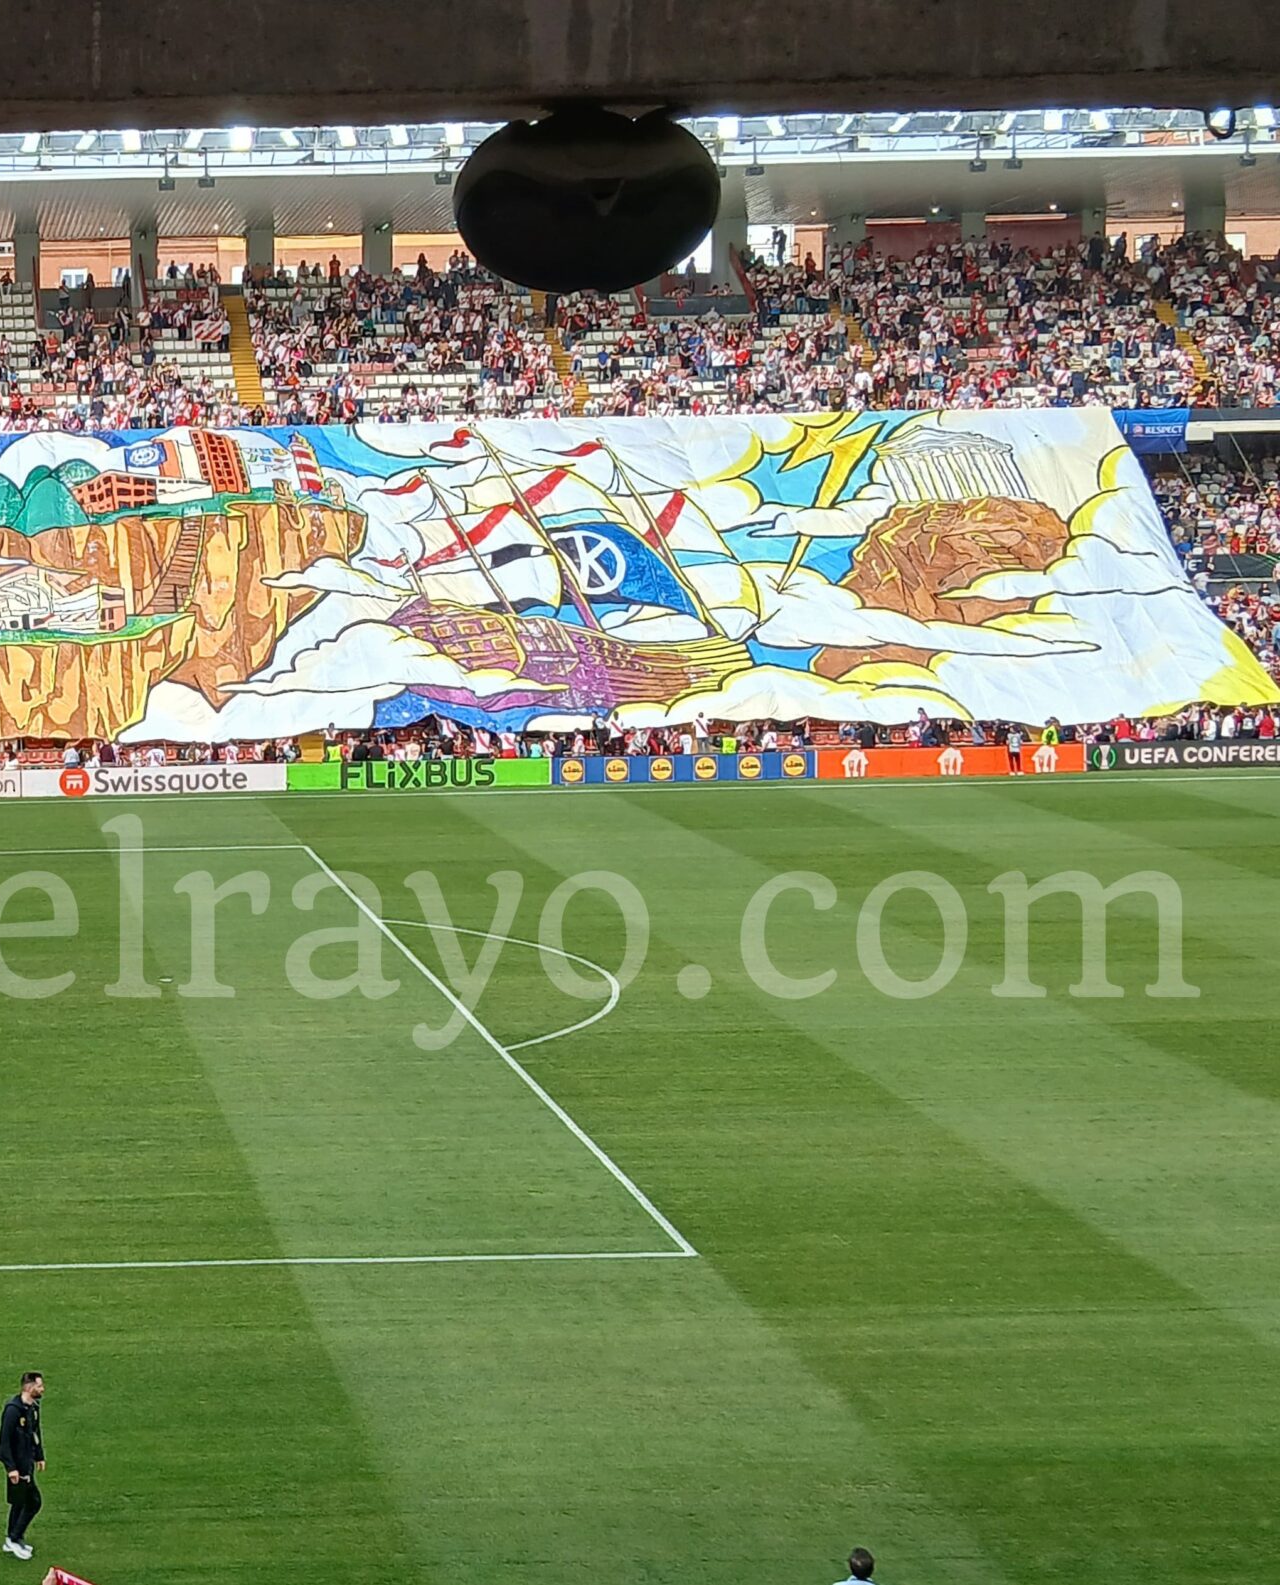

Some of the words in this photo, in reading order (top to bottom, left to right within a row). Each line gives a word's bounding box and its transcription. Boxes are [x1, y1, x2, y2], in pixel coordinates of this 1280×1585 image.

[1144, 424, 1184, 435] RESPECT
[1124, 747, 1180, 765] UEFA
[94, 768, 248, 793] Swissquote
